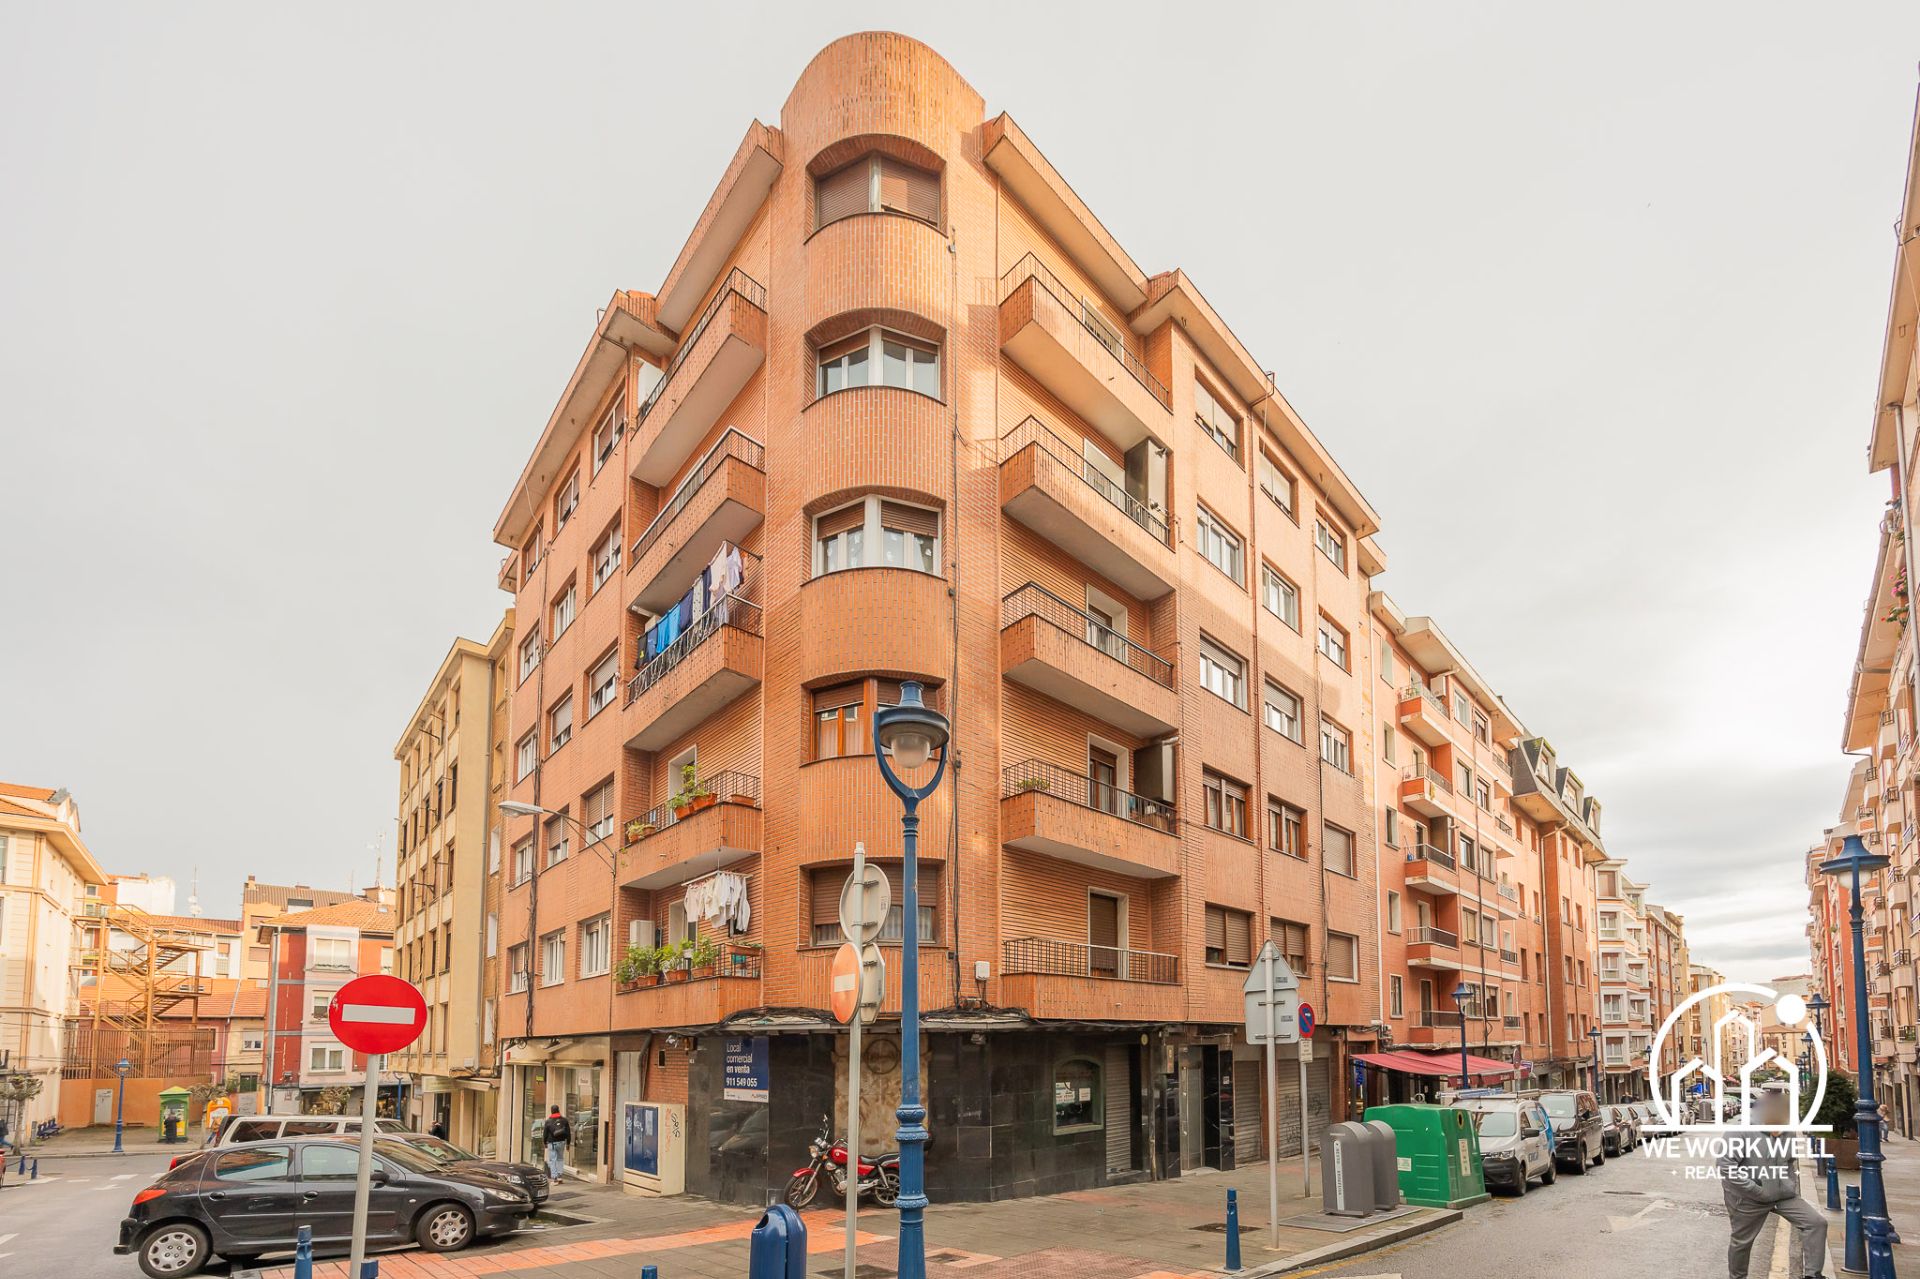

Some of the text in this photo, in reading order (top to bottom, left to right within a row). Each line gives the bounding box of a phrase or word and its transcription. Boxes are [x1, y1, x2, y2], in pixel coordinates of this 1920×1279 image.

[726, 1042, 742, 1053] Local
[726, 1053, 753, 1063] comercial
[726, 1065, 750, 1074] en venta
[726, 1077, 758, 1087] 911 549 055
